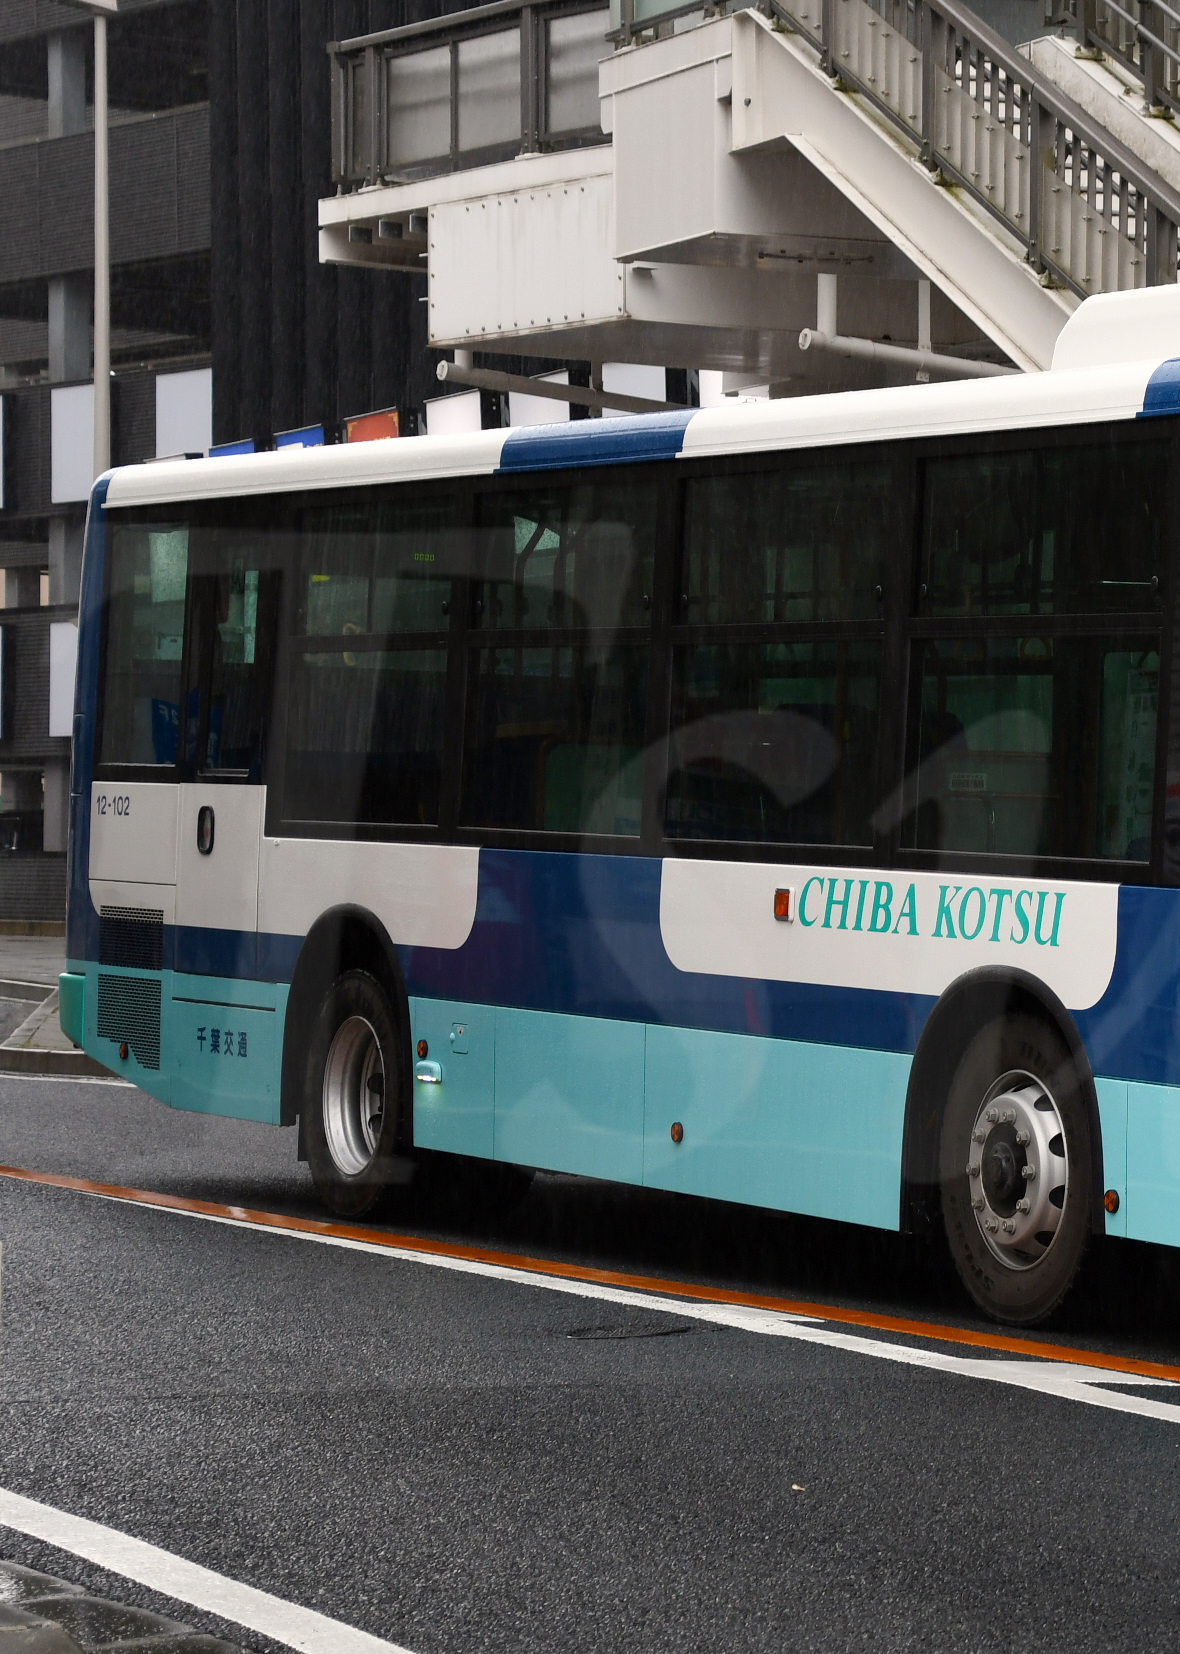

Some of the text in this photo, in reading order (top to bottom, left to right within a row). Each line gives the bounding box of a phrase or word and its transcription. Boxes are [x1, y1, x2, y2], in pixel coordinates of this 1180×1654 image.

[97, 795, 130, 816] 12-102
[798, 876, 1067, 947] CHIBA KOTSU
[196, 1026, 248, 1057] 千葉交通
